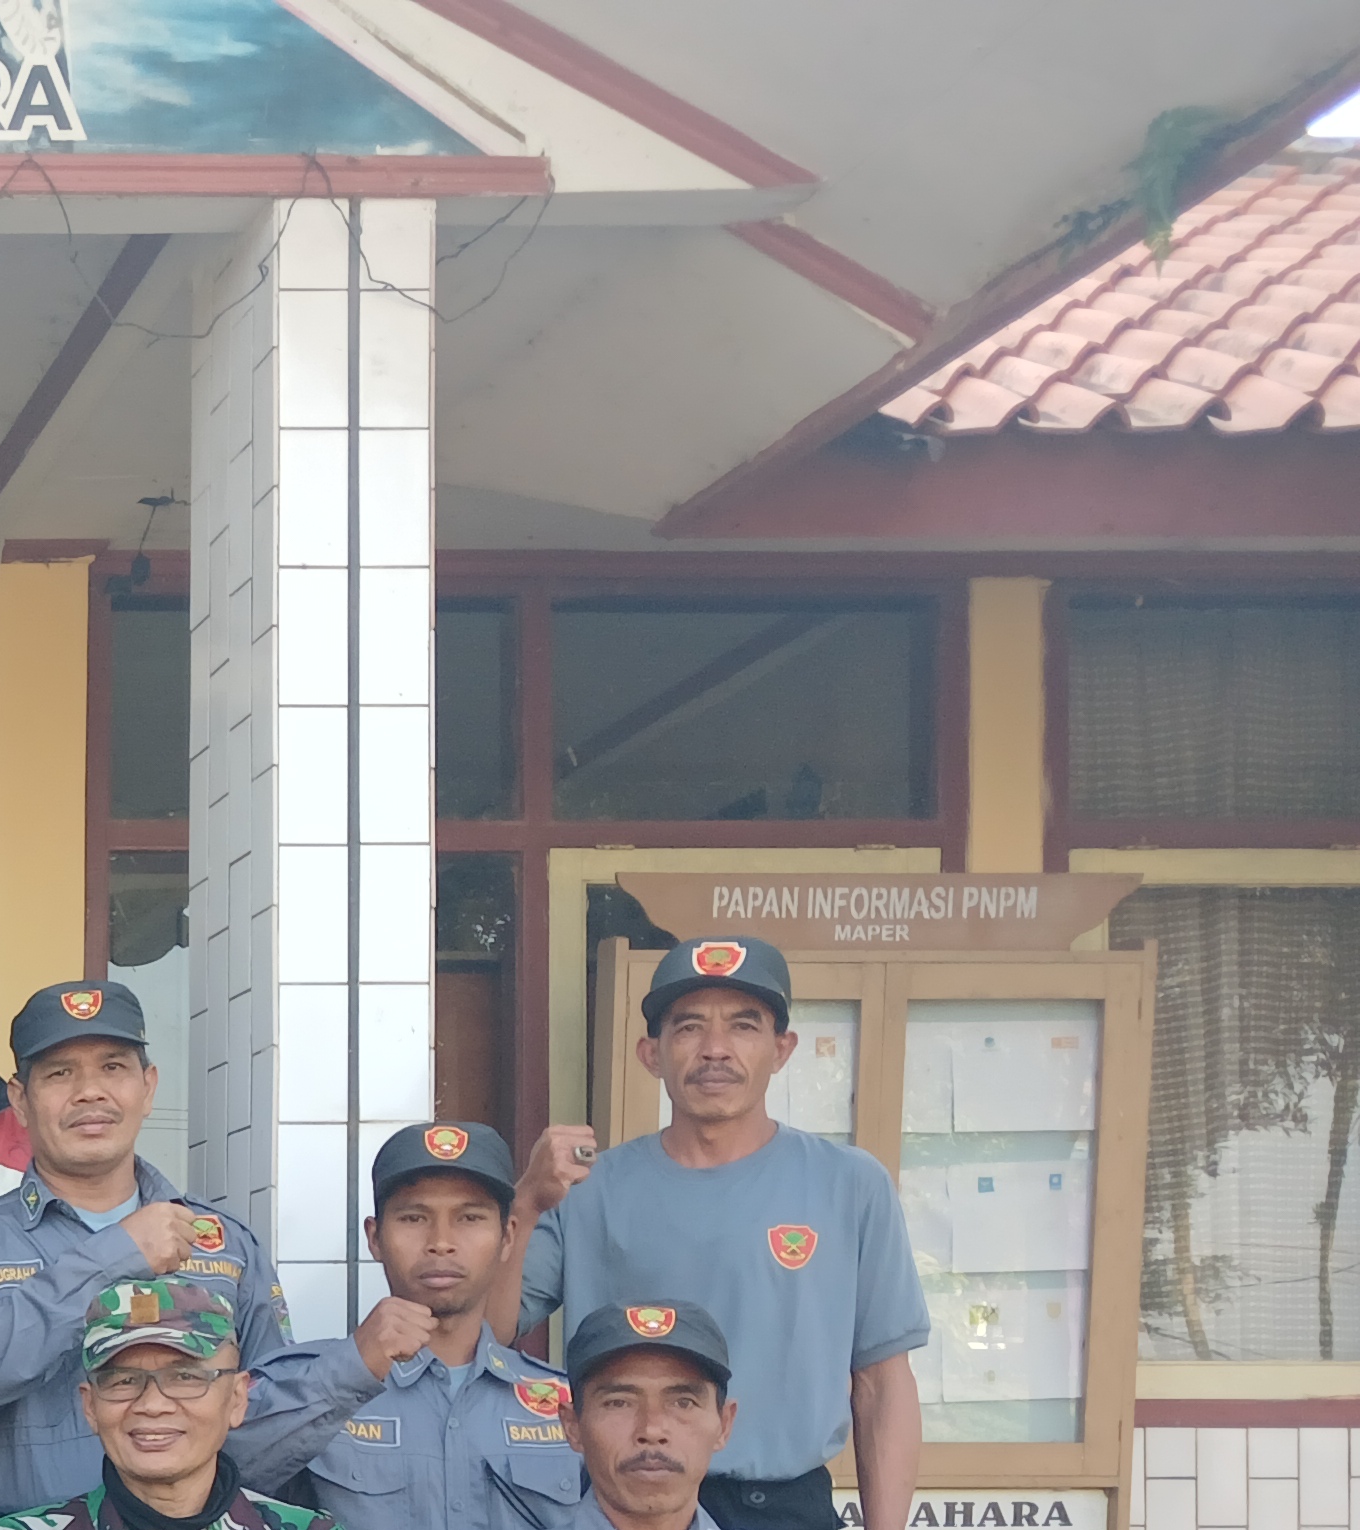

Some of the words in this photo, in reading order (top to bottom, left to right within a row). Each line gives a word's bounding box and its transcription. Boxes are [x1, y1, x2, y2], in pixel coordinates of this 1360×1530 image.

[712, 886, 800, 919] PAPAN
[807, 886, 954, 920] INFORMASI
[962, 886, 1038, 919] PNPM
[834, 924, 910, 942] MAPER
[909, 1500, 1073, 1528] AHARA
